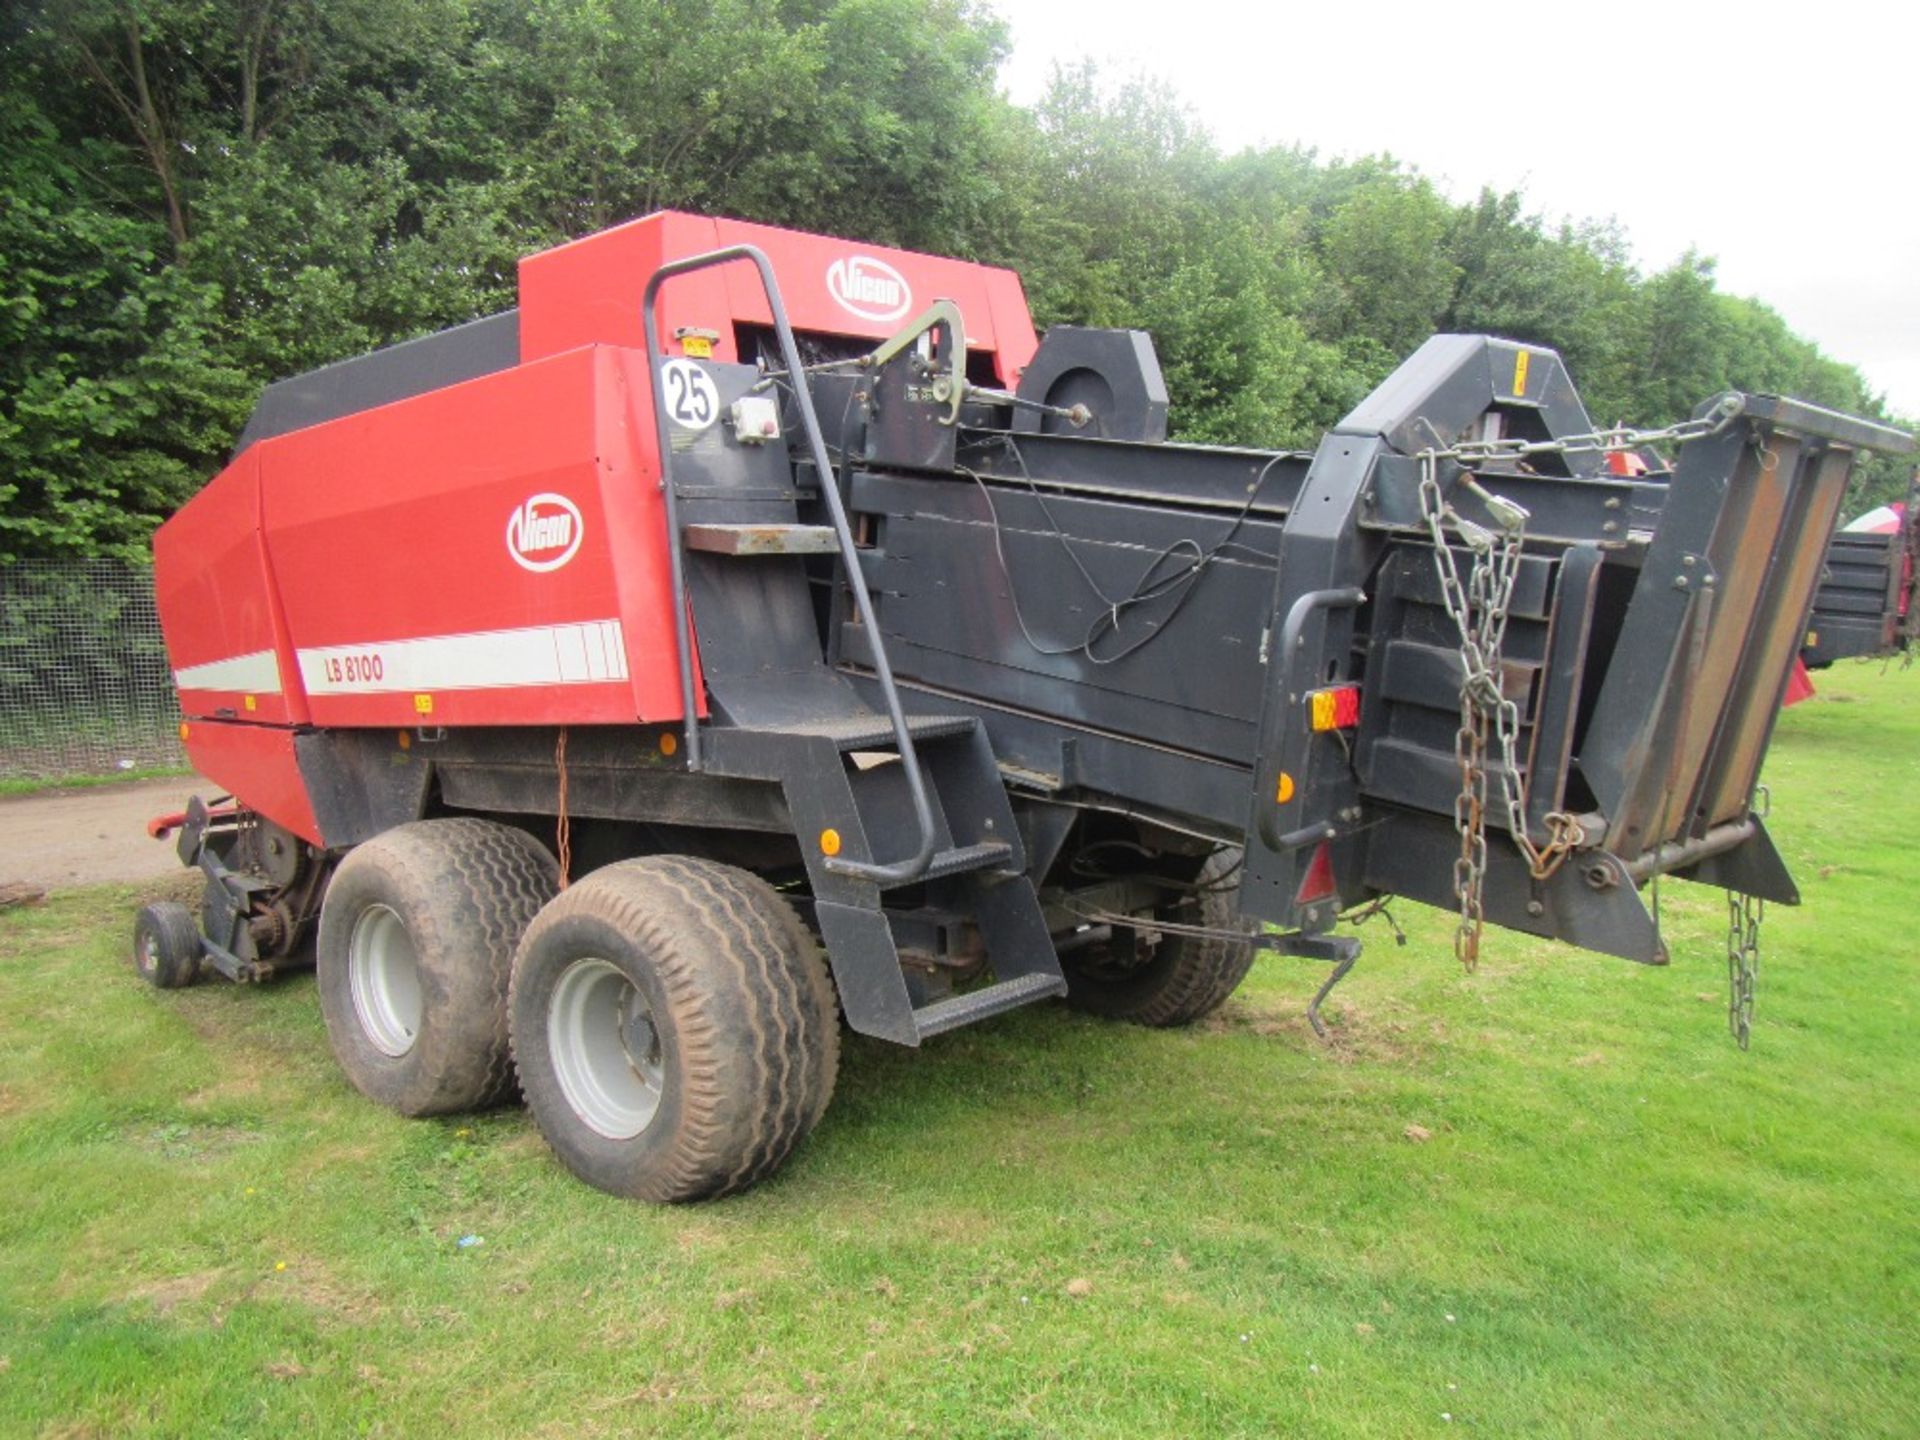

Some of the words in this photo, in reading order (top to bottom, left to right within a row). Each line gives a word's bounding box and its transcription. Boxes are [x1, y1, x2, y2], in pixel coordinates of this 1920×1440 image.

[839, 258, 901, 306] Vicon
[669, 366, 711, 423] 25
[517, 498, 572, 552] Vicon
[325, 657, 342, 682] LB
[345, 654, 383, 682] 8100
